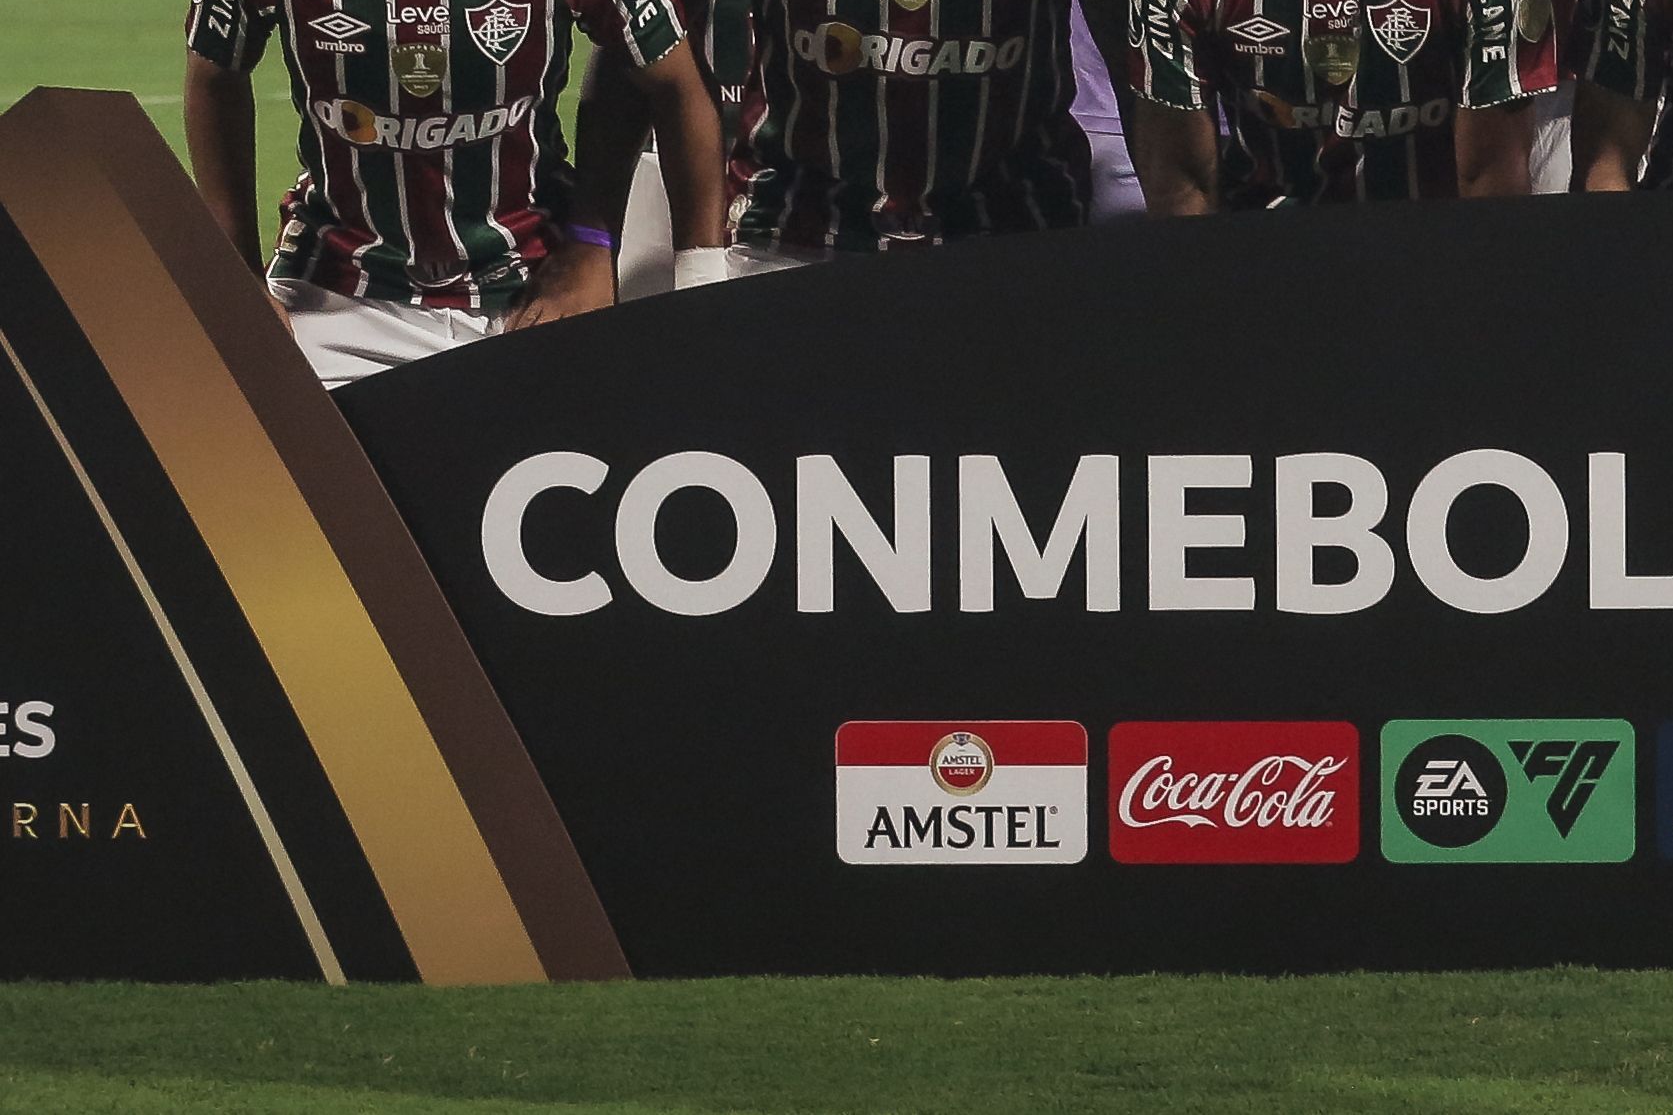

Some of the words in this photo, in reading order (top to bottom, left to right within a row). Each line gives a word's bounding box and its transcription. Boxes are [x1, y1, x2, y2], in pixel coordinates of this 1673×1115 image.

[386, 3, 450, 24] Leve
[315, 40, 366, 54] umbro
[794, 20, 1021, 76] OBRIGADO
[1234, 42, 1285, 55] umbro
[314, 95, 534, 151] OBRIGADO
[941, 755, 983, 765] AMSTEL
[947, 768, 977, 776] LAGER
[1118, 755, 1349, 829] Coca-Cola
[1414, 759, 1488, 798] EA
[12, 802, 147, 840] RNA
[1412, 798, 1489, 817] SPORTS
[863, 805, 1062, 849] AMSTEL
